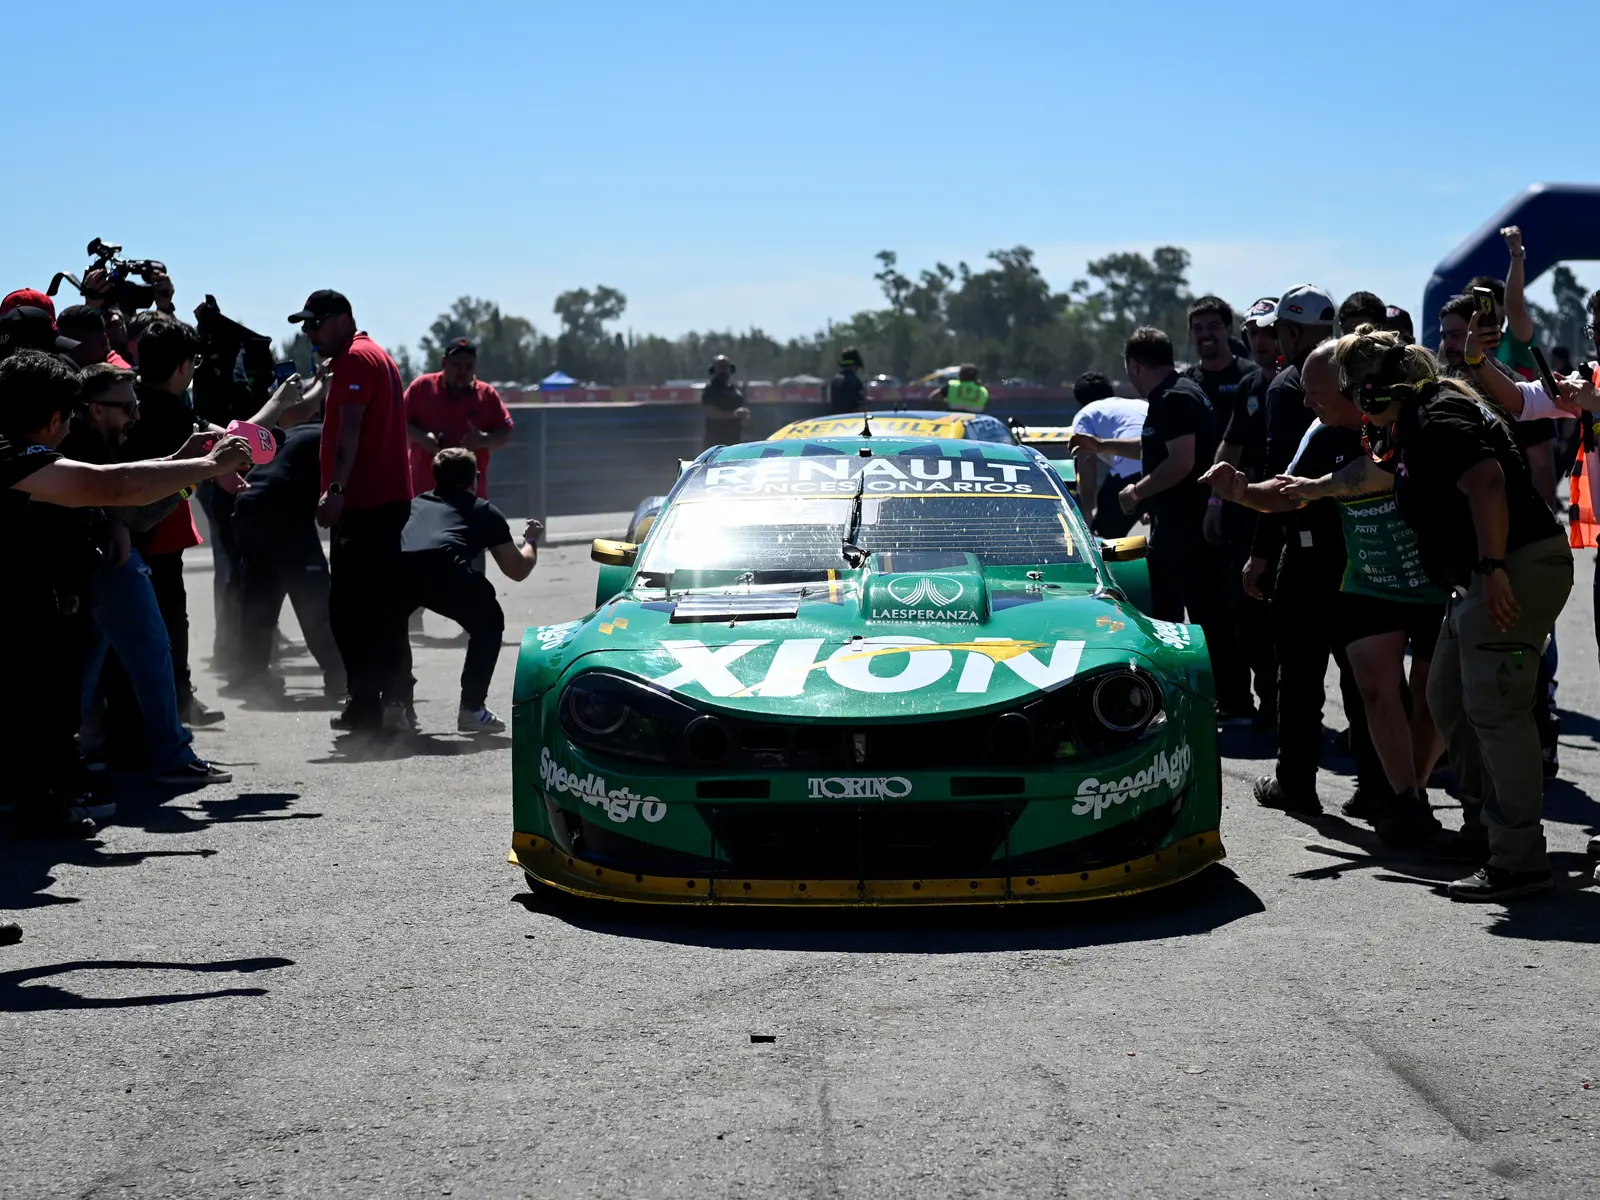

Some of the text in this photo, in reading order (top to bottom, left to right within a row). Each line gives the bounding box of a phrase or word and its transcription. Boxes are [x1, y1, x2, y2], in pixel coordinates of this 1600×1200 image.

[705, 459, 1031, 486] RENAULT
[703, 480, 1033, 495] CONCESONARIOS
[872, 608, 979, 620] LAESPERANZA
[648, 636, 1086, 698] XION
[539, 746, 668, 824] SpeedAgro
[807, 776, 913, 801] TORINO
[1071, 743, 1191, 820] SpeedAgro
